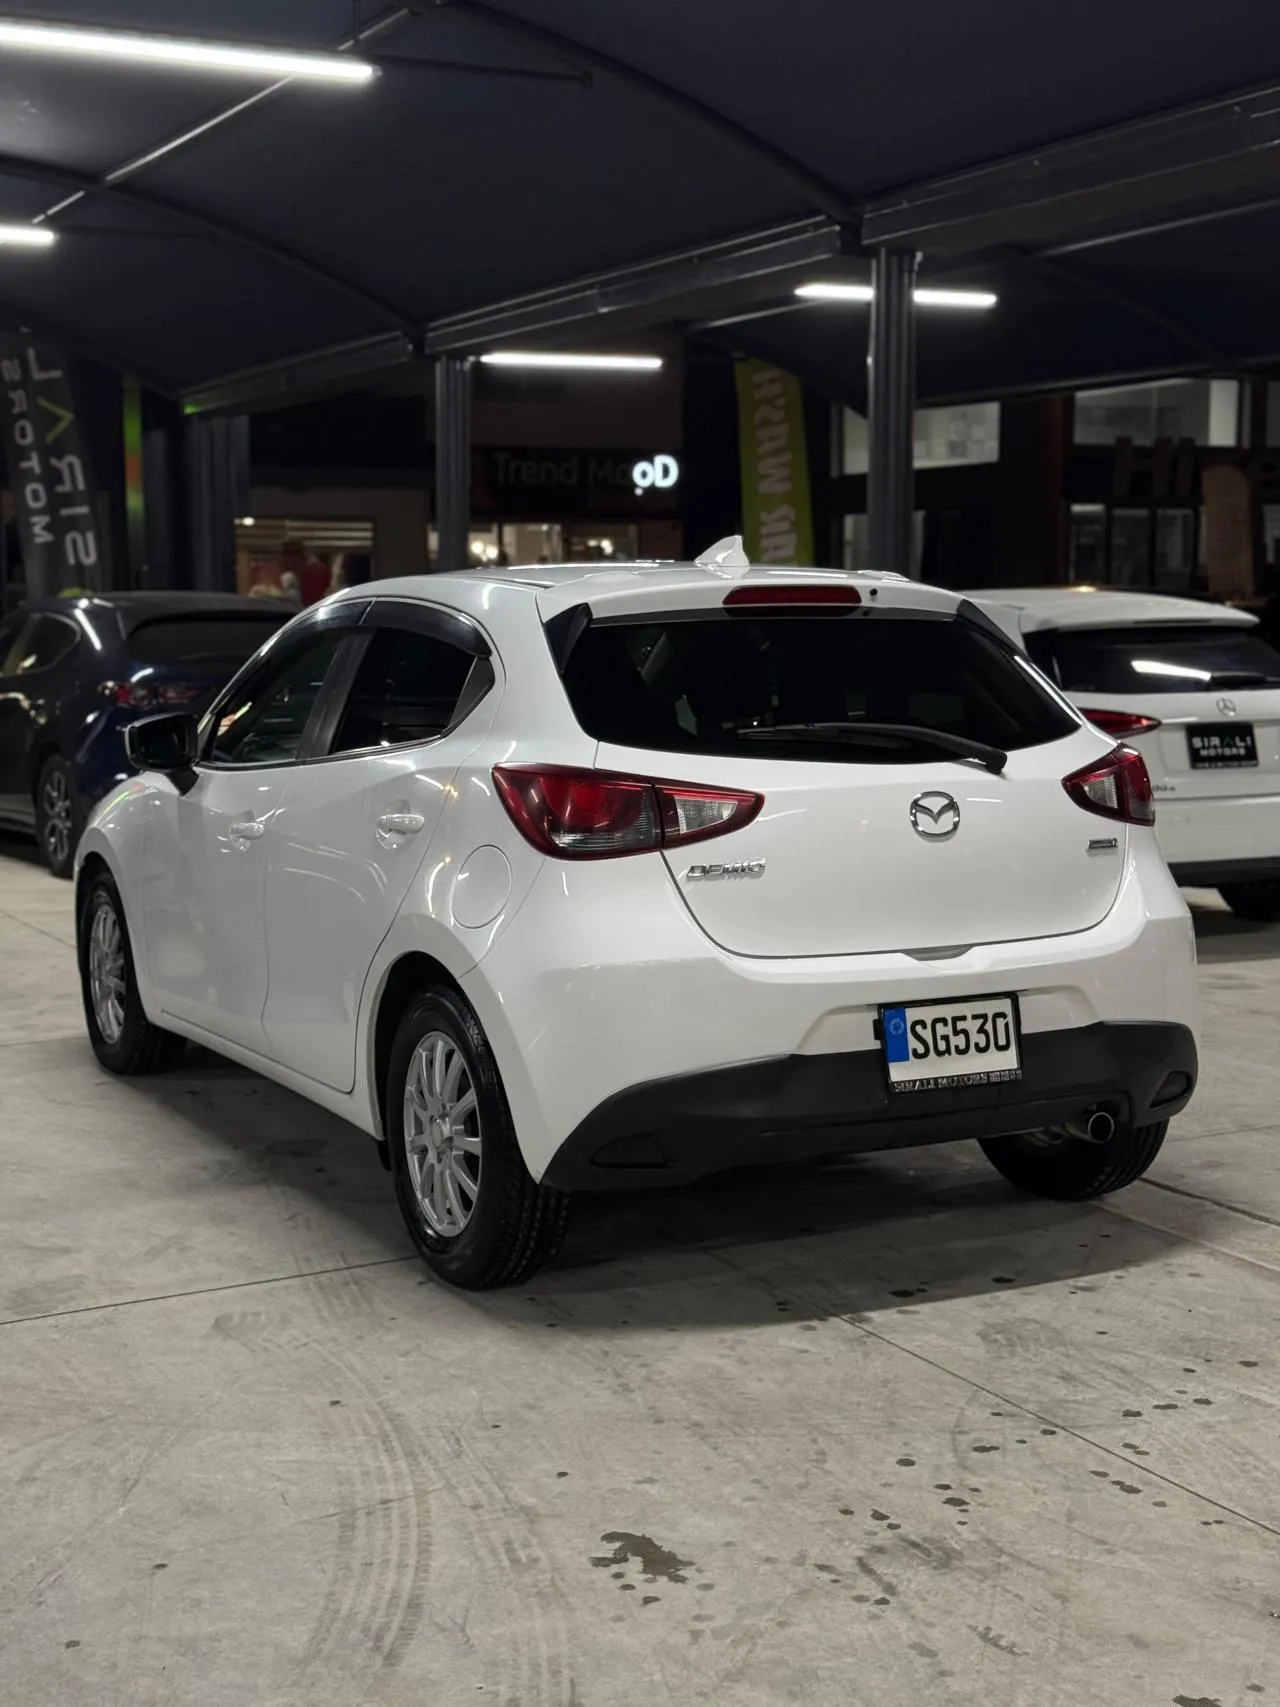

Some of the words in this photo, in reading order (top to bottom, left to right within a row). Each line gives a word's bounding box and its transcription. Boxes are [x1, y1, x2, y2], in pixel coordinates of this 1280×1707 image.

[491, 451, 579, 486] Trend
[1192, 736, 1252, 749] SIRALI
[1200, 748, 1246, 757] MOTORS
[909, 1011, 1011, 1060] SG530
[893, 1079, 935, 1093] SIRALI
[938, 1072, 988, 1088] MOTORS
